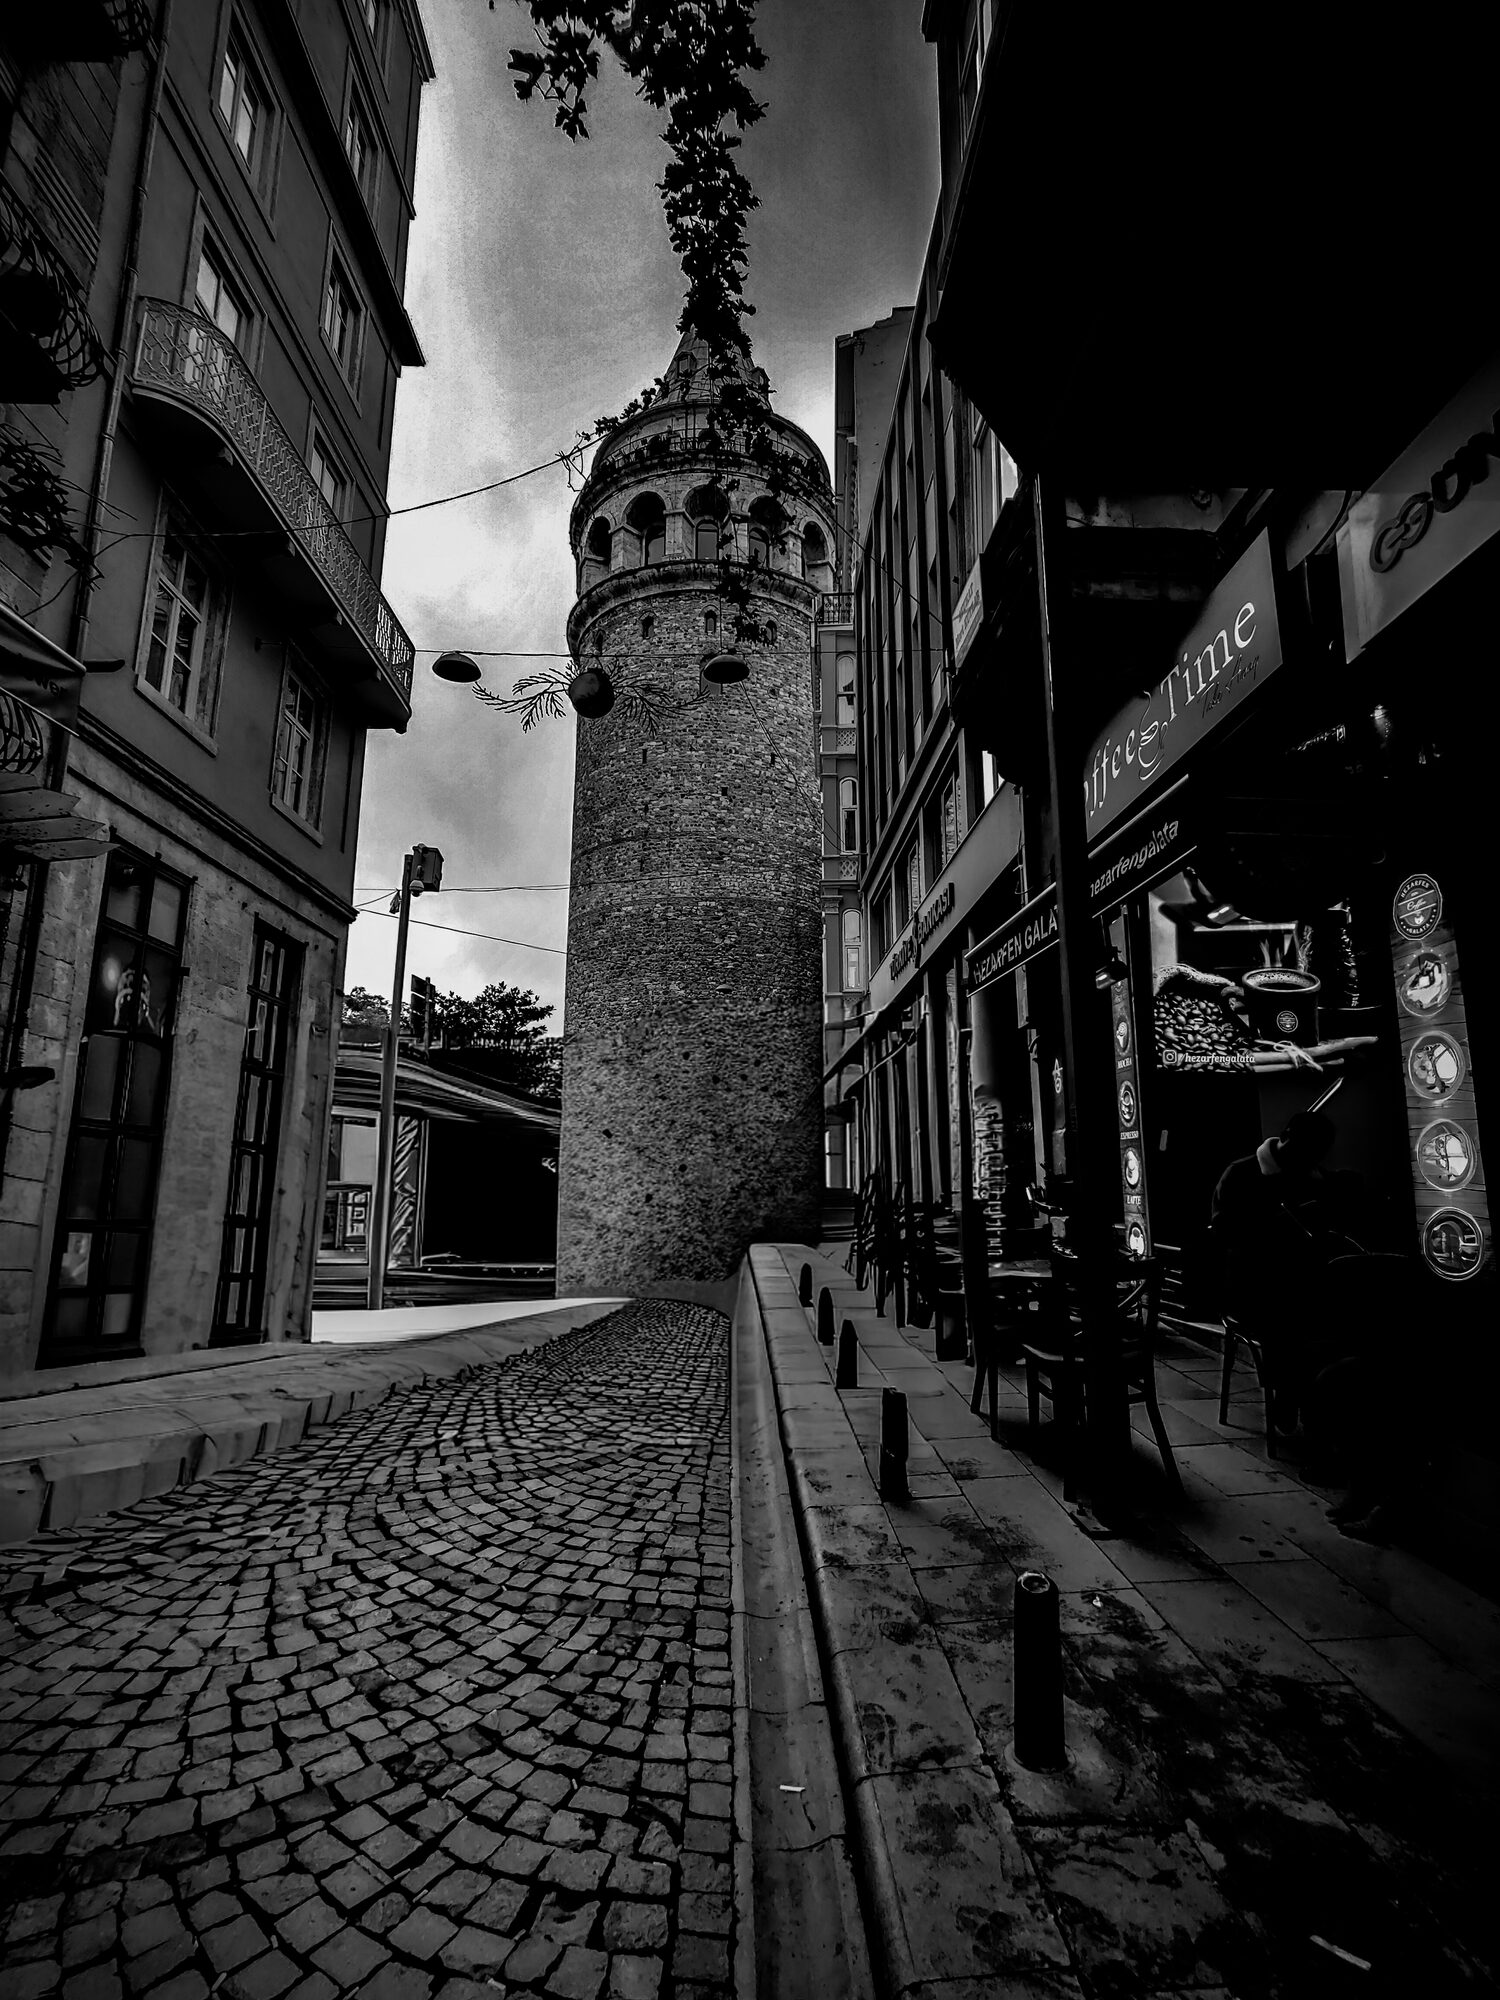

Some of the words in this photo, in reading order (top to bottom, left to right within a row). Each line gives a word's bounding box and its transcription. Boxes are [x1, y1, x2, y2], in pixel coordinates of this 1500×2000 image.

[1159, 601, 1257, 723] Time
[973, 931, 1022, 985] HEZARFEN
[1024, 904, 1059, 950] GALA
